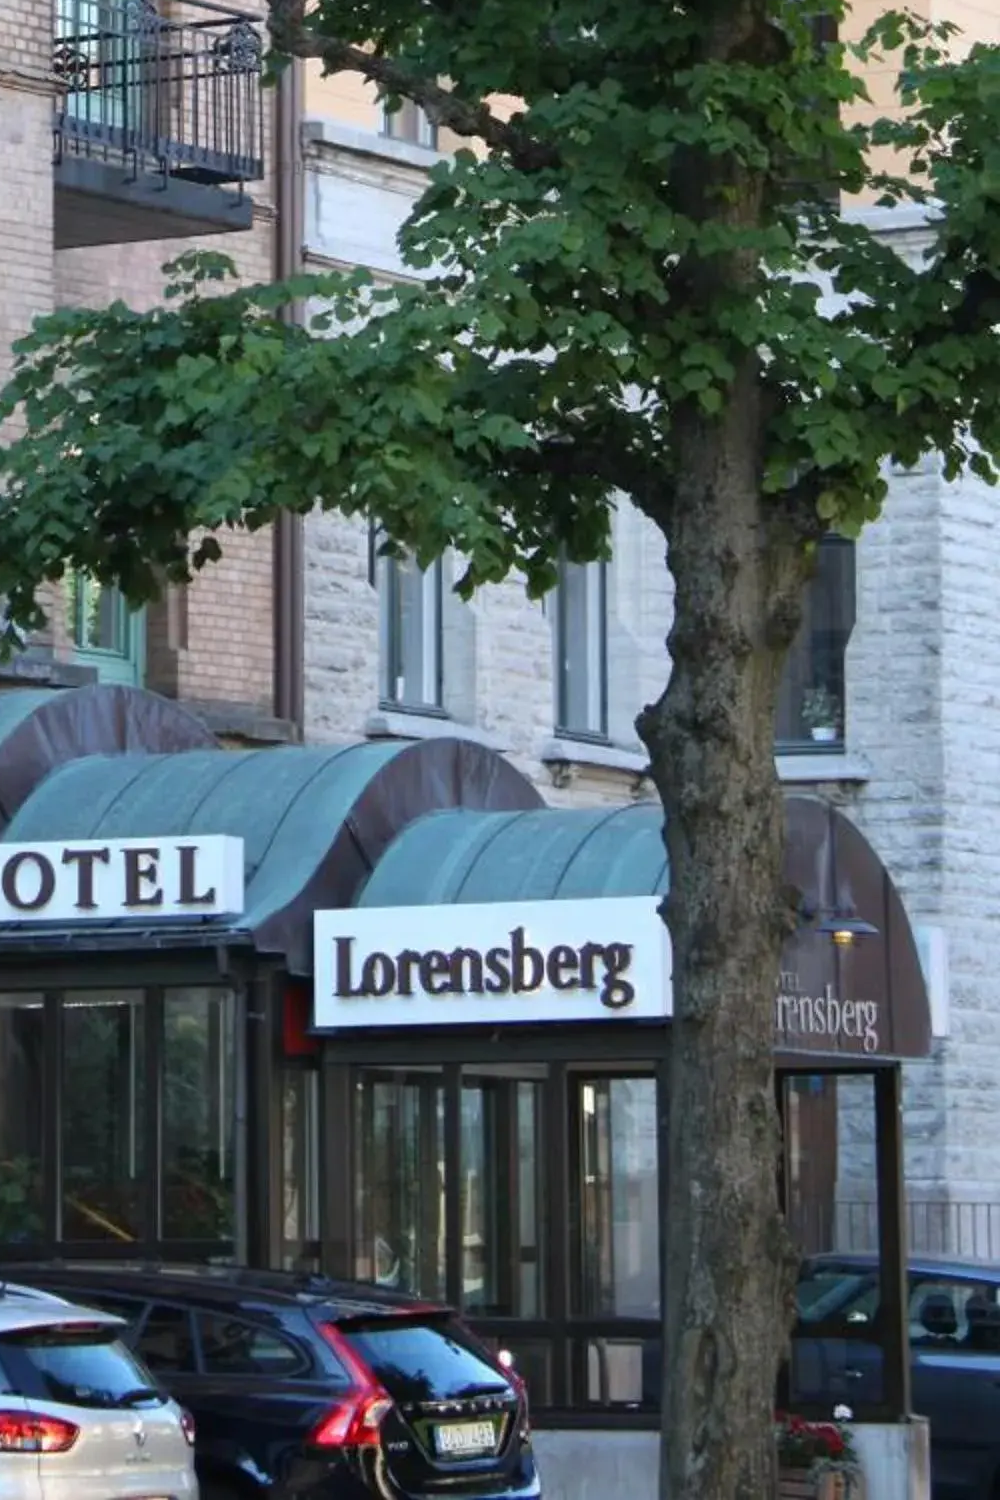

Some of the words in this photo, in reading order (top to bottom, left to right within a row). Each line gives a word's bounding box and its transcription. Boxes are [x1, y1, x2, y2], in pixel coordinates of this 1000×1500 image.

[332, 926, 635, 1009] Lorensberg
[776, 972, 806, 992] TEL
[775, 984, 879, 1052] rensberg
